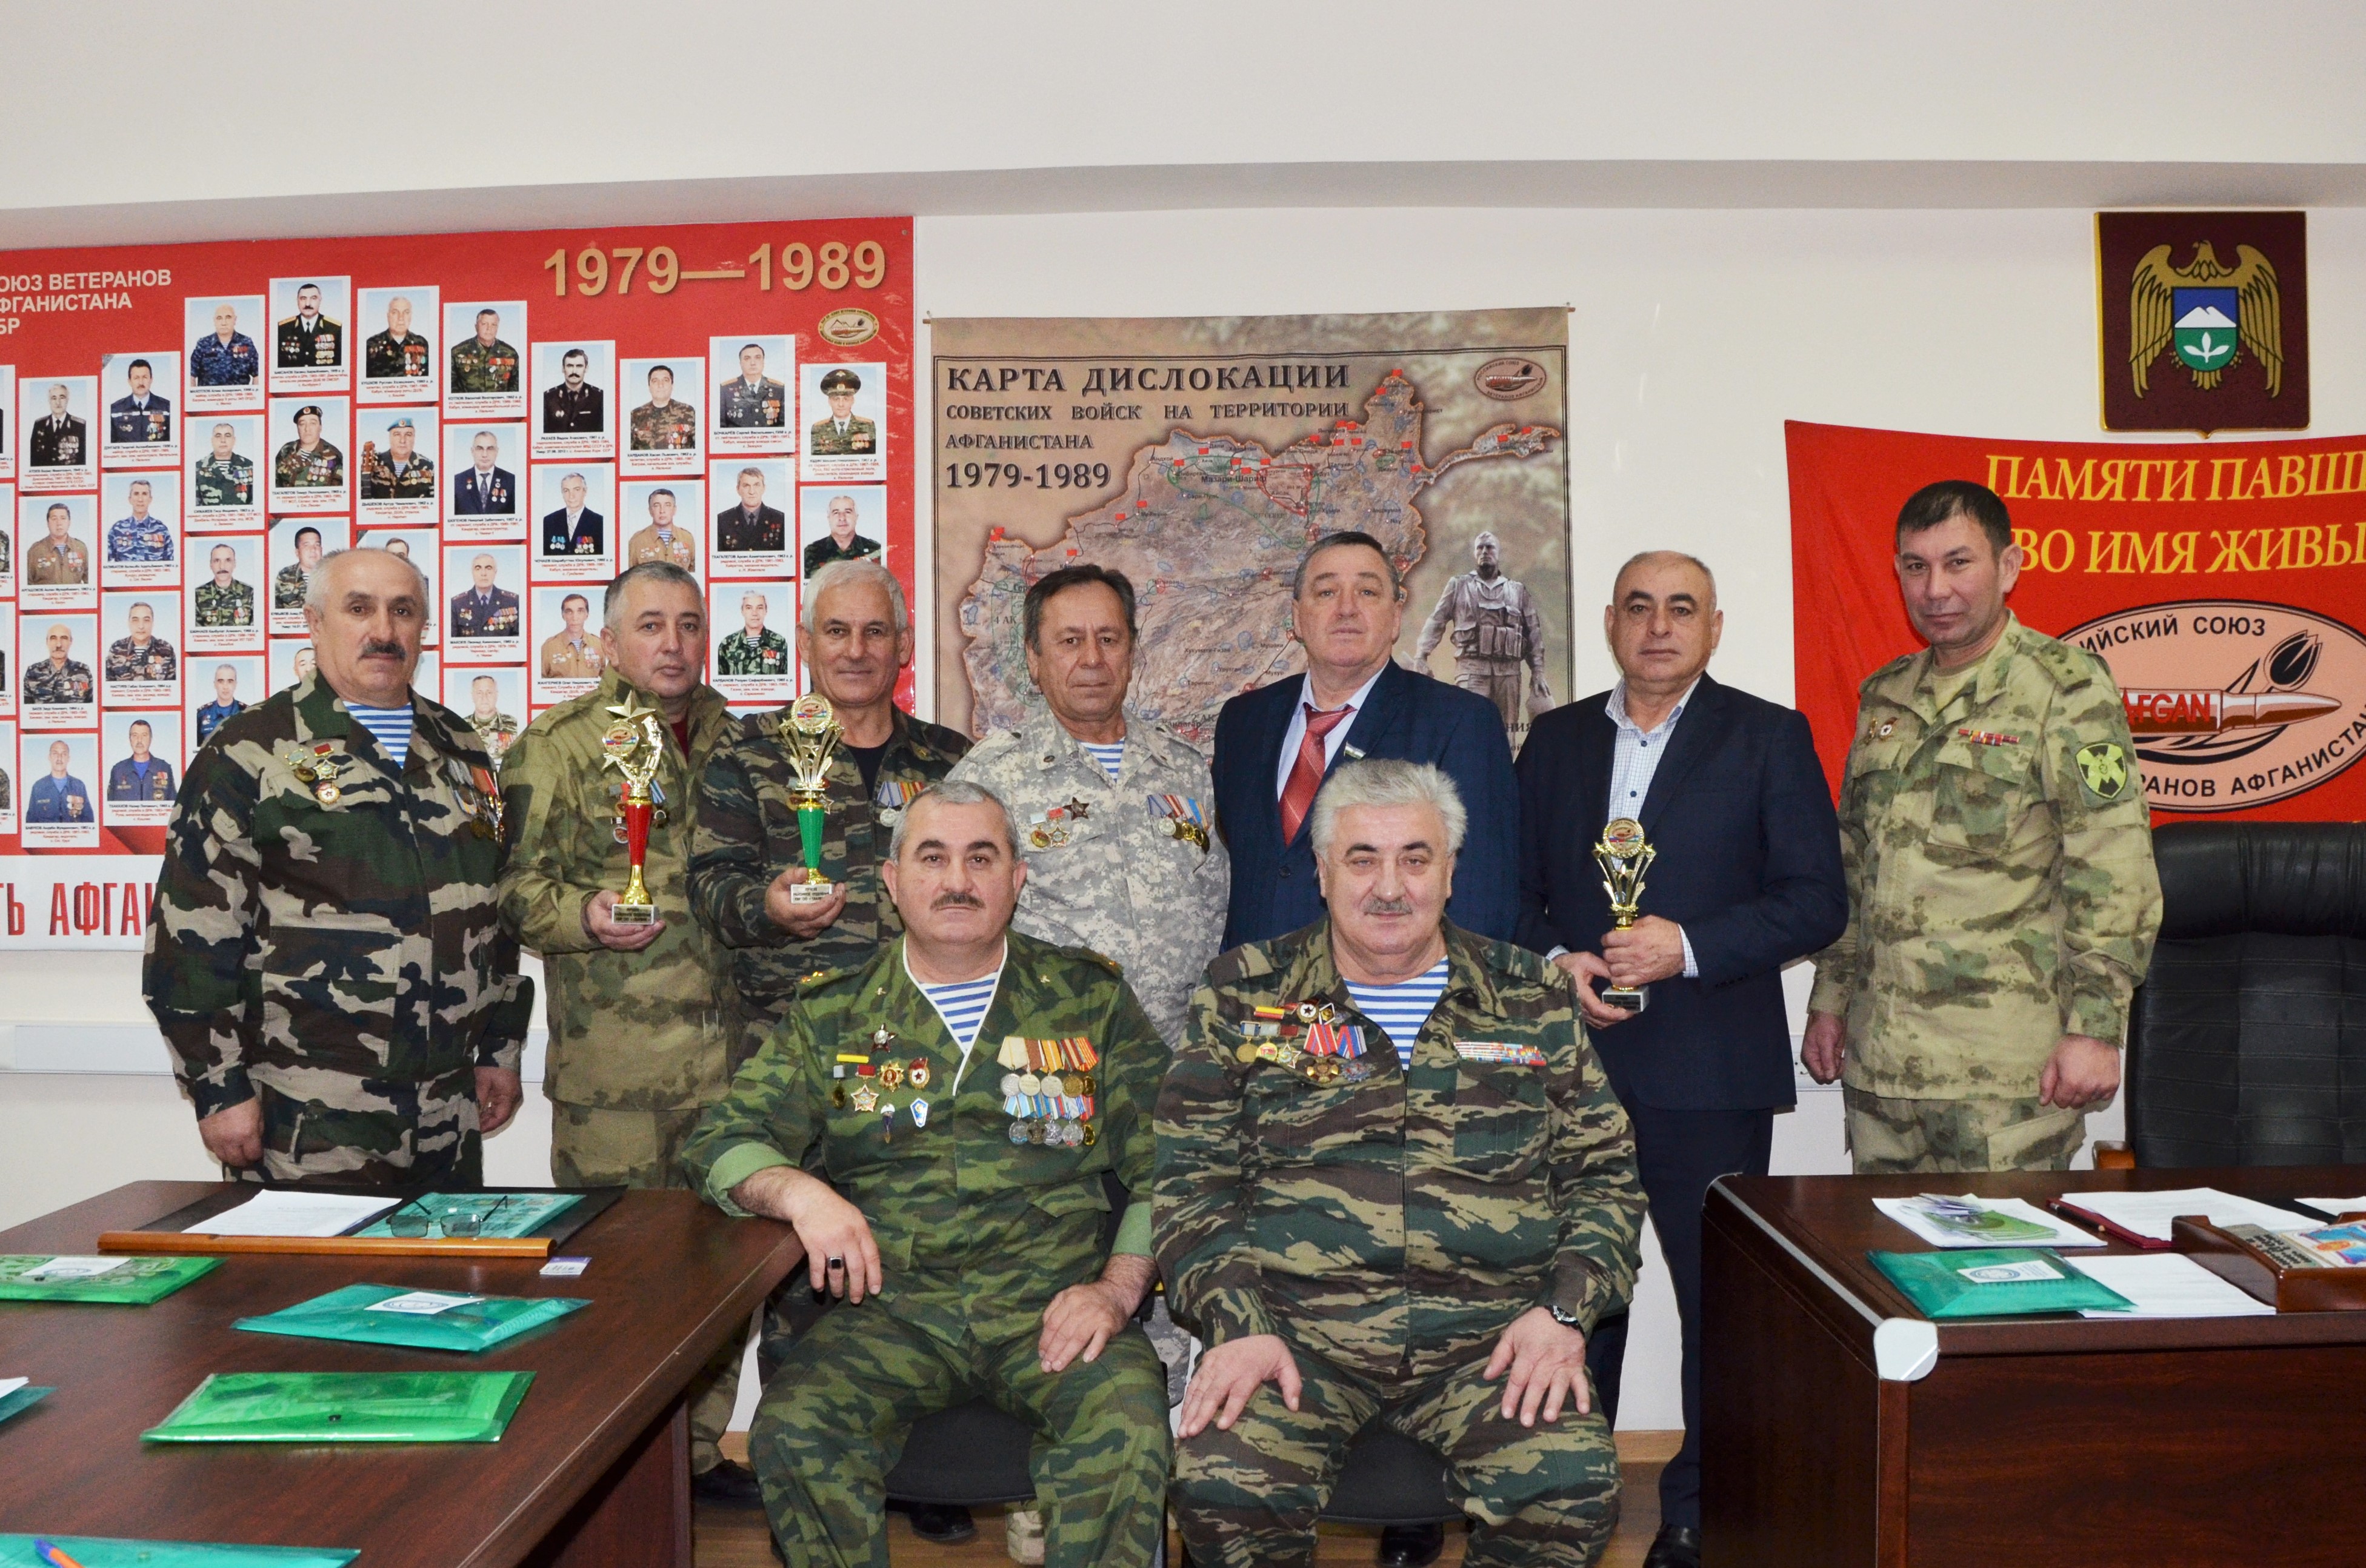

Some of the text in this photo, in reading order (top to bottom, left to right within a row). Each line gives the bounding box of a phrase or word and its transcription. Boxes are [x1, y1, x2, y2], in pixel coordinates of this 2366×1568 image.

[49, 269, 172, 291] ВЕТЕРАНОВ
[947, 365, 1350, 396] КАРТА ДИСЛОКАЦИИ
[946, 401, 1349, 420] СОВЕТСКИХ ВОЙСК НА ТЕРРИТОРИИ
[945, 434, 1094, 450] АФГАНИСТАНА
[946, 462, 1112, 489] 1979-1989
[1986, 451, 2366, 501] ПАМЯТИ ПАВШ
[2010, 522, 2366, 574] ВО ИМЯ ЖИВЫ
[2193, 616, 2265, 636] СОЮЗ
[2140, 710, 2366, 797] АНОВ АФГАНИСТА
[0, 883, 25, 935] Ь
